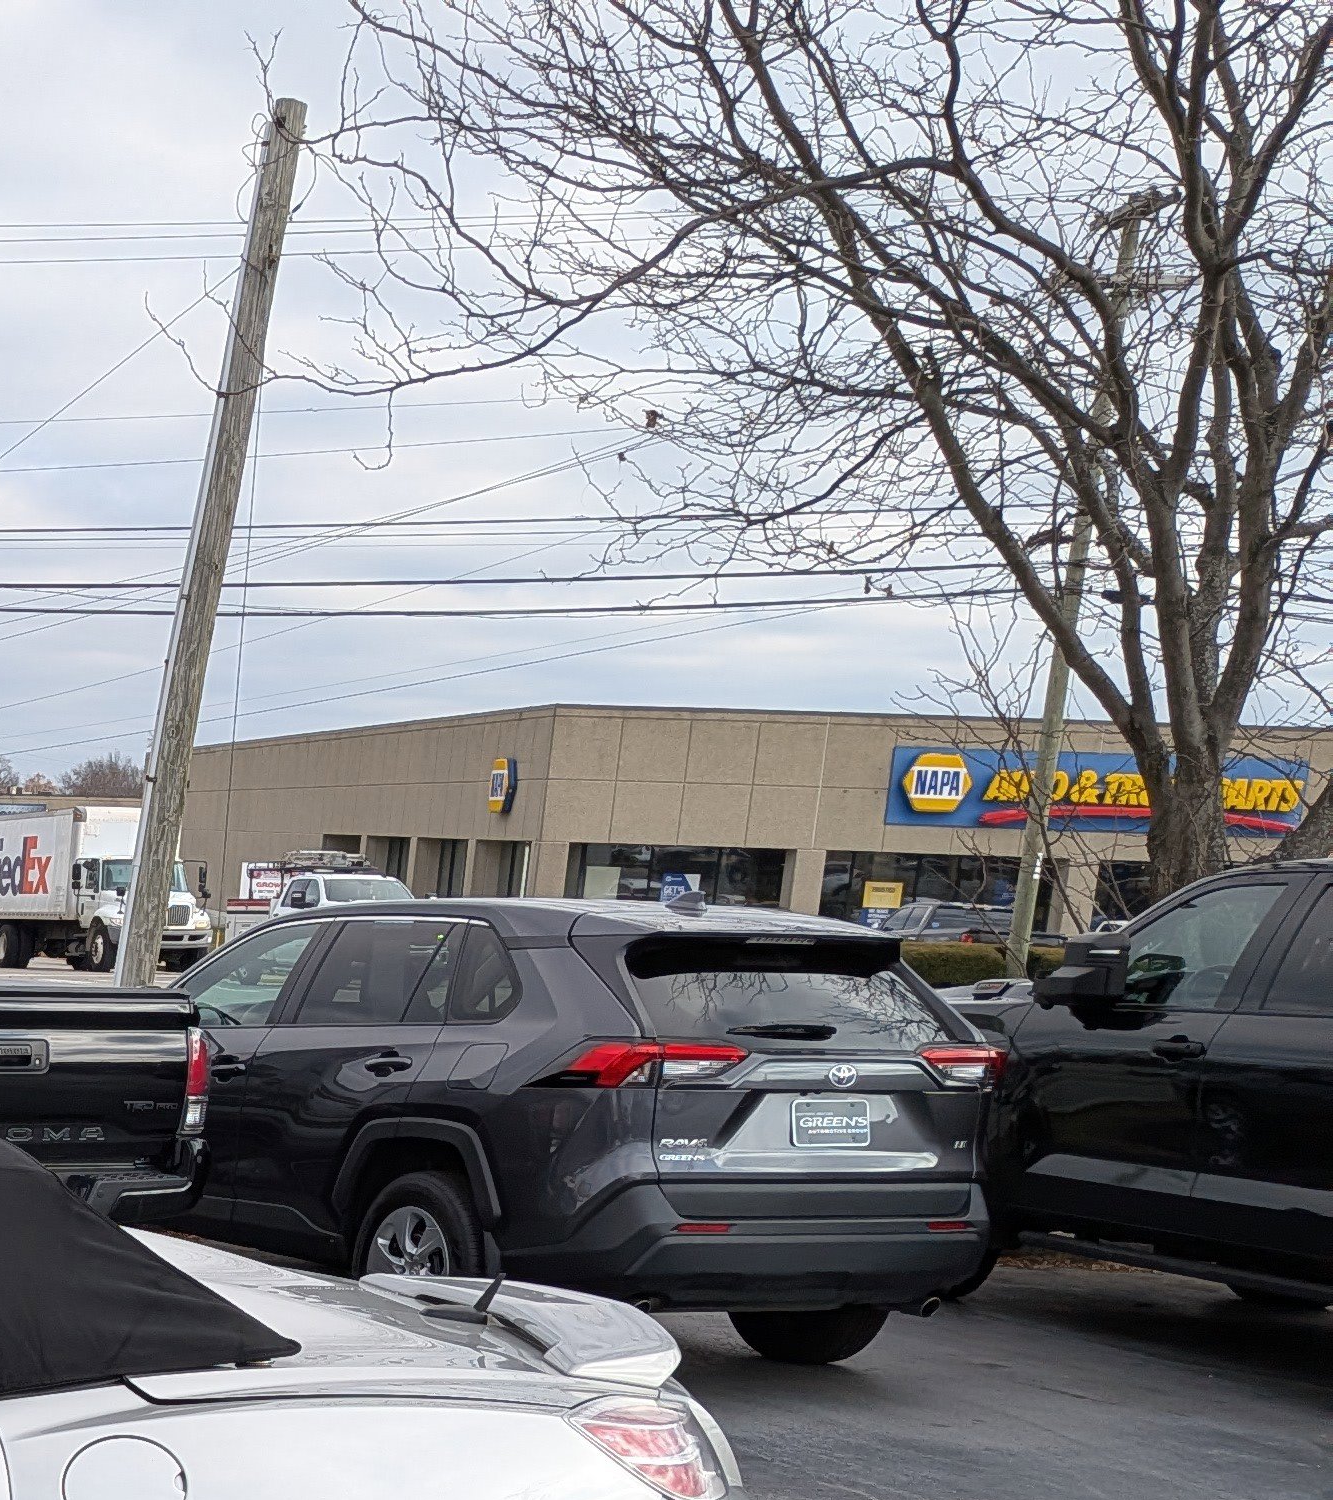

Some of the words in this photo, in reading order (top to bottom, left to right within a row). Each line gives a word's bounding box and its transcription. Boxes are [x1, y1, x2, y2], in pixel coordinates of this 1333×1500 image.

[914, 769, 961, 796] NAPA
[124, 1100, 154, 1111] TRD
[155, 1102, 179, 1110] PRO
[799, 1116, 868, 1127] GREEN'S
[658, 1138, 708, 1148] RAV4
